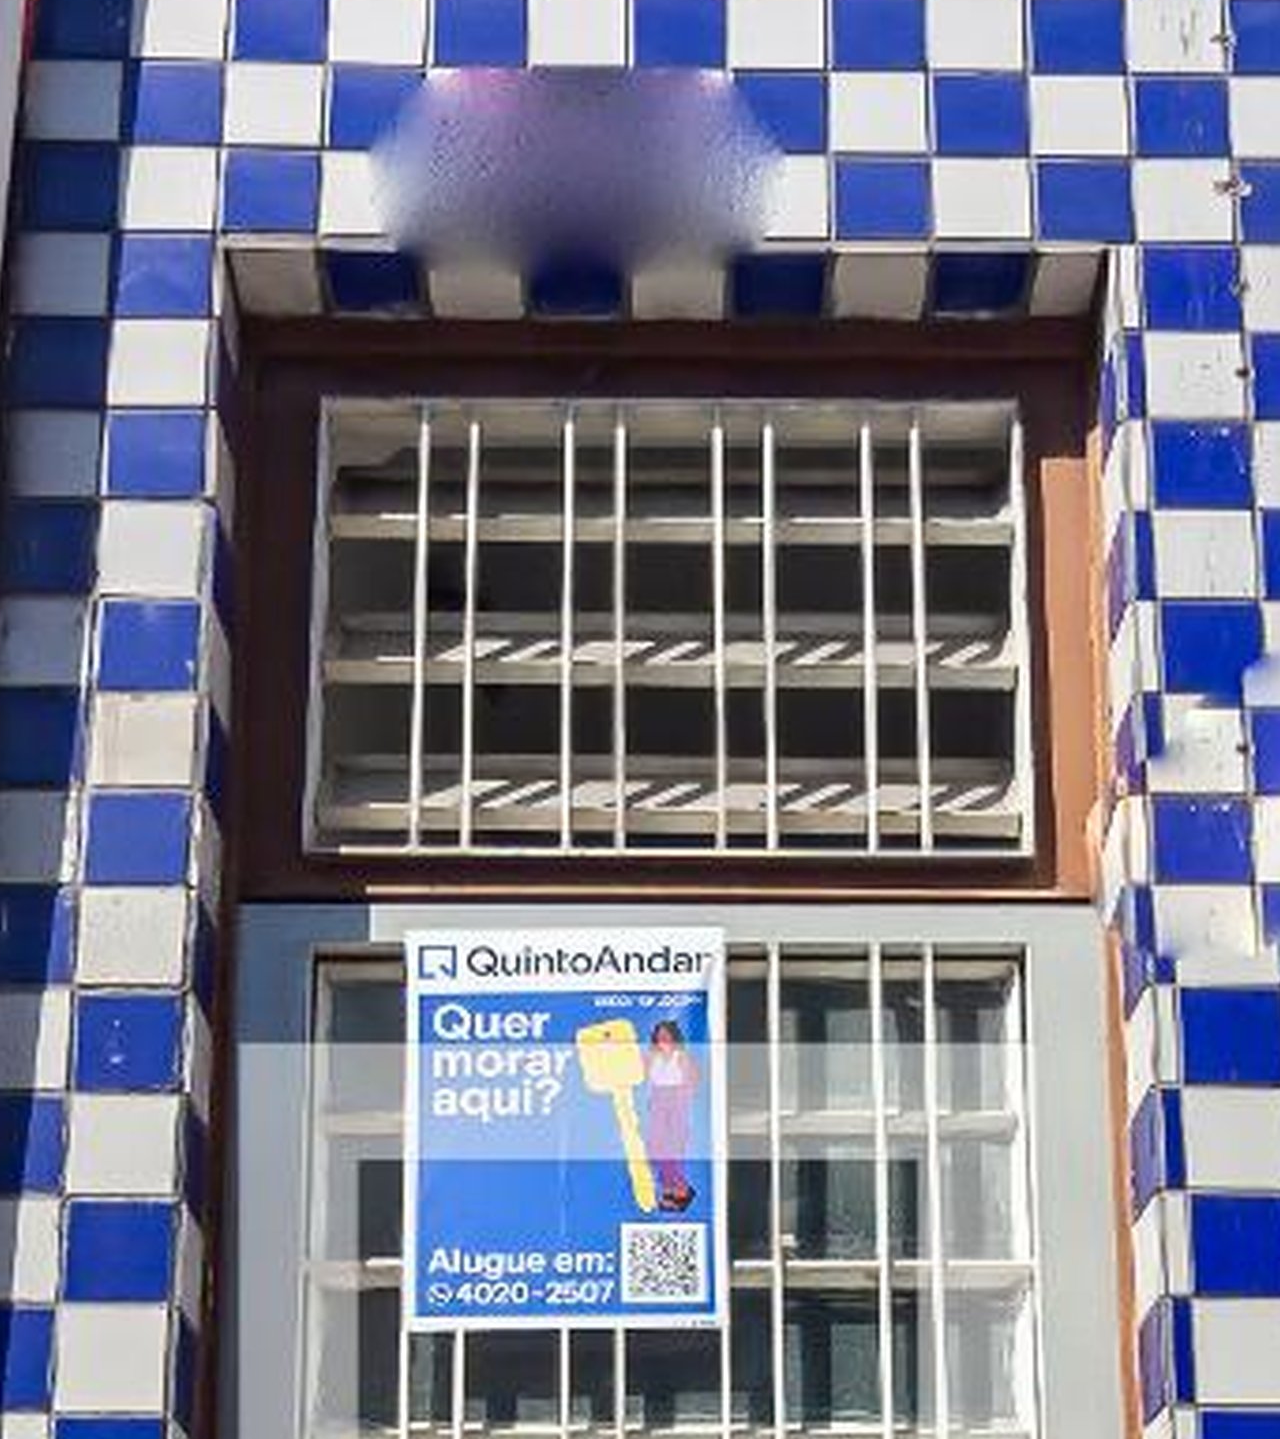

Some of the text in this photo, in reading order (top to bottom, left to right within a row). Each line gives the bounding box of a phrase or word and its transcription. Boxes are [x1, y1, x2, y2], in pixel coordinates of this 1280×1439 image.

[466, 945, 712, 977] QuintoAndar
[432, 1004, 549, 1041] Quer
[432, 1049, 572, 1077] morar
[432, 1081, 562, 1122] aqui?
[428, 1248, 614, 1279] Alugue em:
